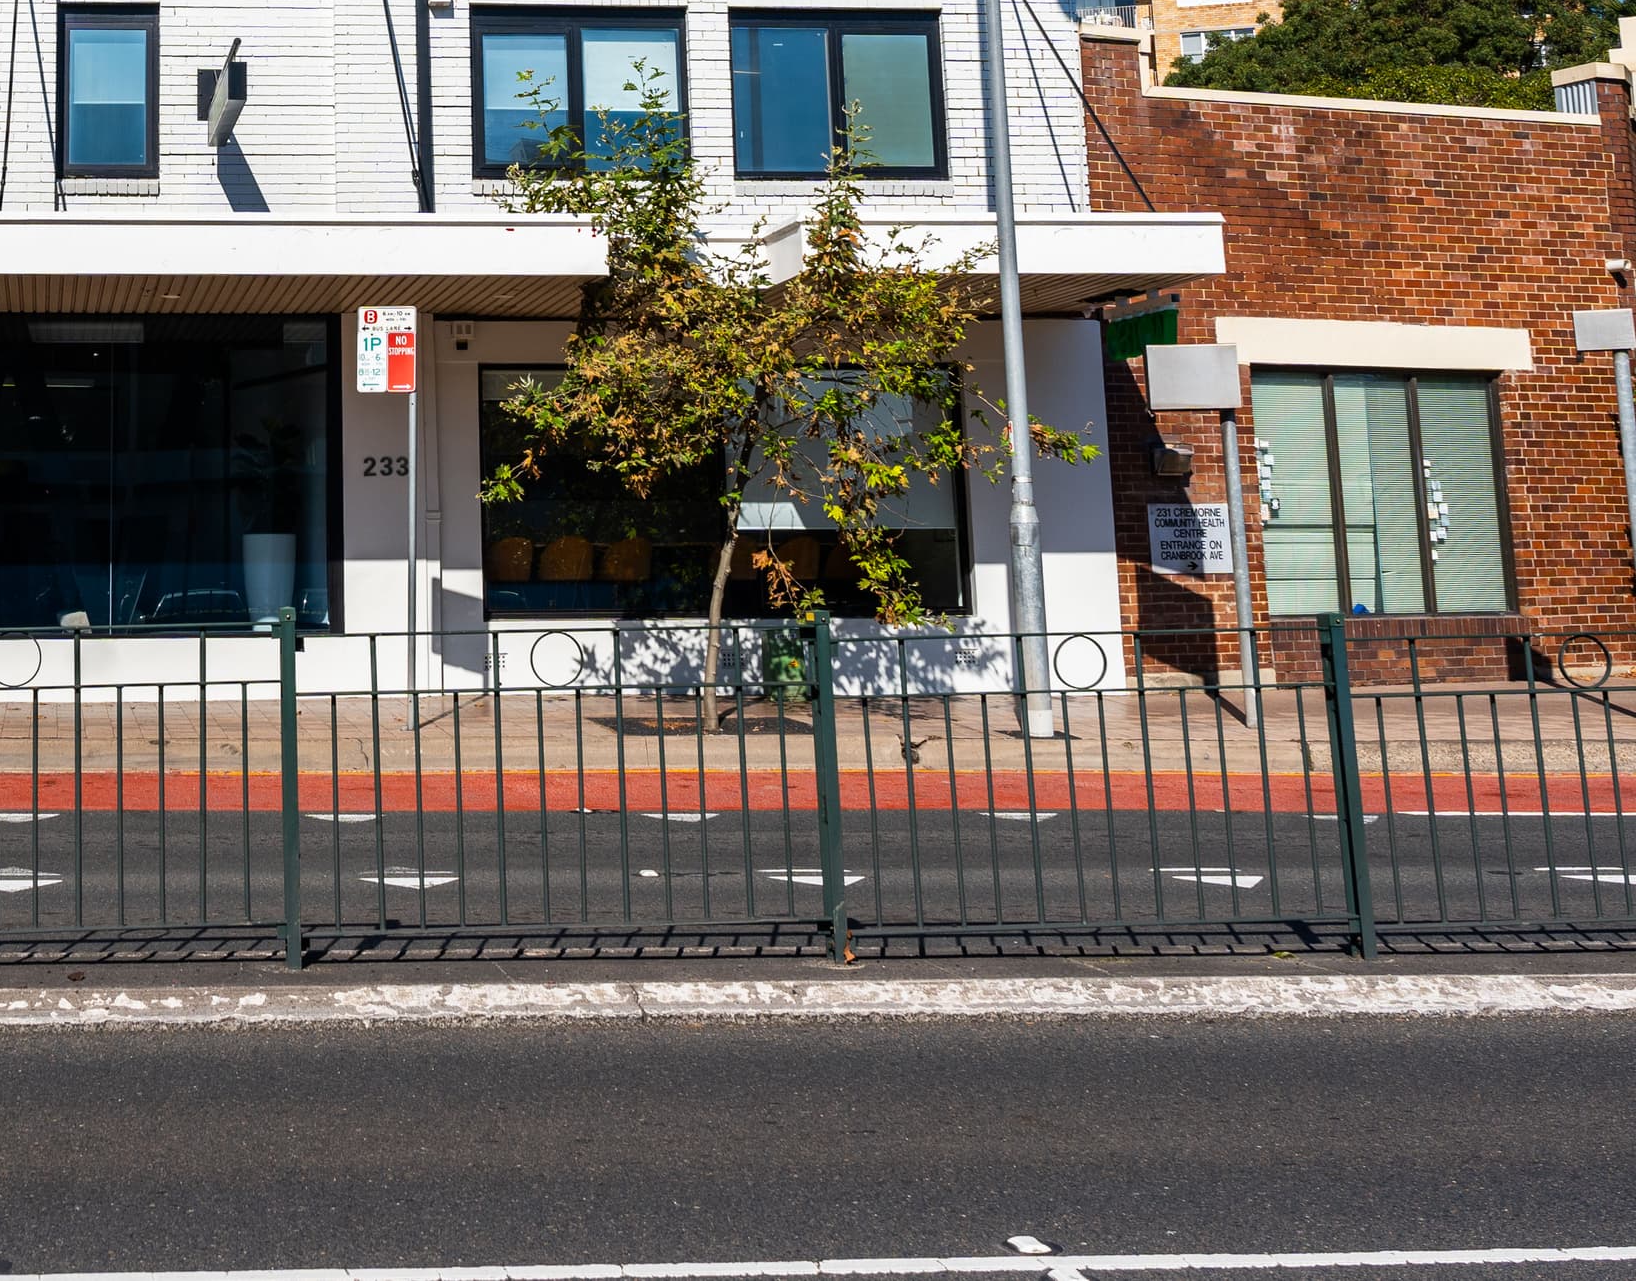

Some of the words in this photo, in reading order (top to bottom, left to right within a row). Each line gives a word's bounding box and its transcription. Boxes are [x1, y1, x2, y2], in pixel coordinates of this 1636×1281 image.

[363, 337, 381, 351] 1P
[395, 336, 407, 345] NO
[388, 347, 414, 355] STOPPING
[363, 456, 410, 477] 233
[1156, 507, 1171, 517] 231
[1173, 507, 1222, 517] CREMORNE
[1154, 518, 1195, 528] COMMUNITY
[1198, 519, 1225, 528] HEALTH
[1173, 529, 1208, 538] CENTRE
[1160, 541, 1206, 550] ENTRANCE
[1209, 541, 1222, 549] ON
[1160, 551, 1208, 560] CRANBROOK
[1209, 551, 1224, 560] AVE
